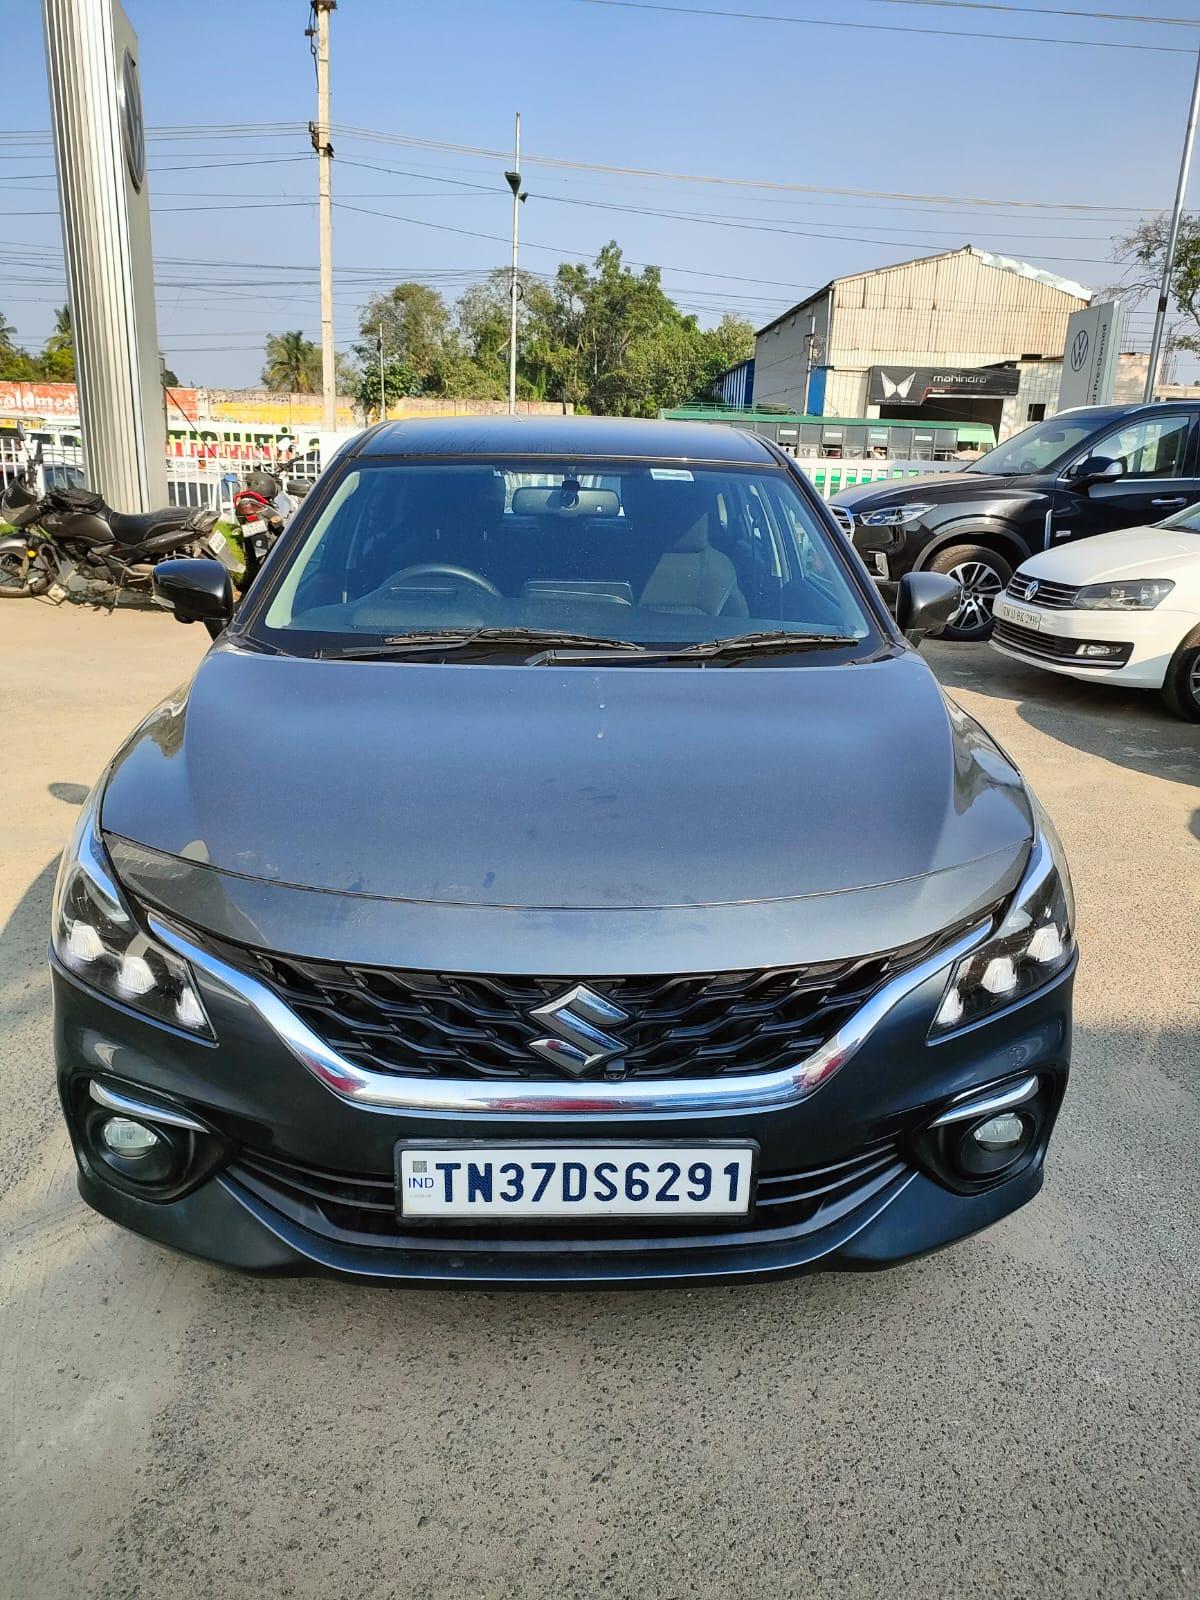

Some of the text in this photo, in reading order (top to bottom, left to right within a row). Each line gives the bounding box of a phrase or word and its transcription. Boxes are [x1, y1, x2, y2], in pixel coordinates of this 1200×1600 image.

[1093, 324, 1107, 391] Pre-Owned
[933, 375, 987, 384] mahindra
[408, 1177, 435, 1189] IND
[435, 1162, 739, 1203] TN37DS6291
